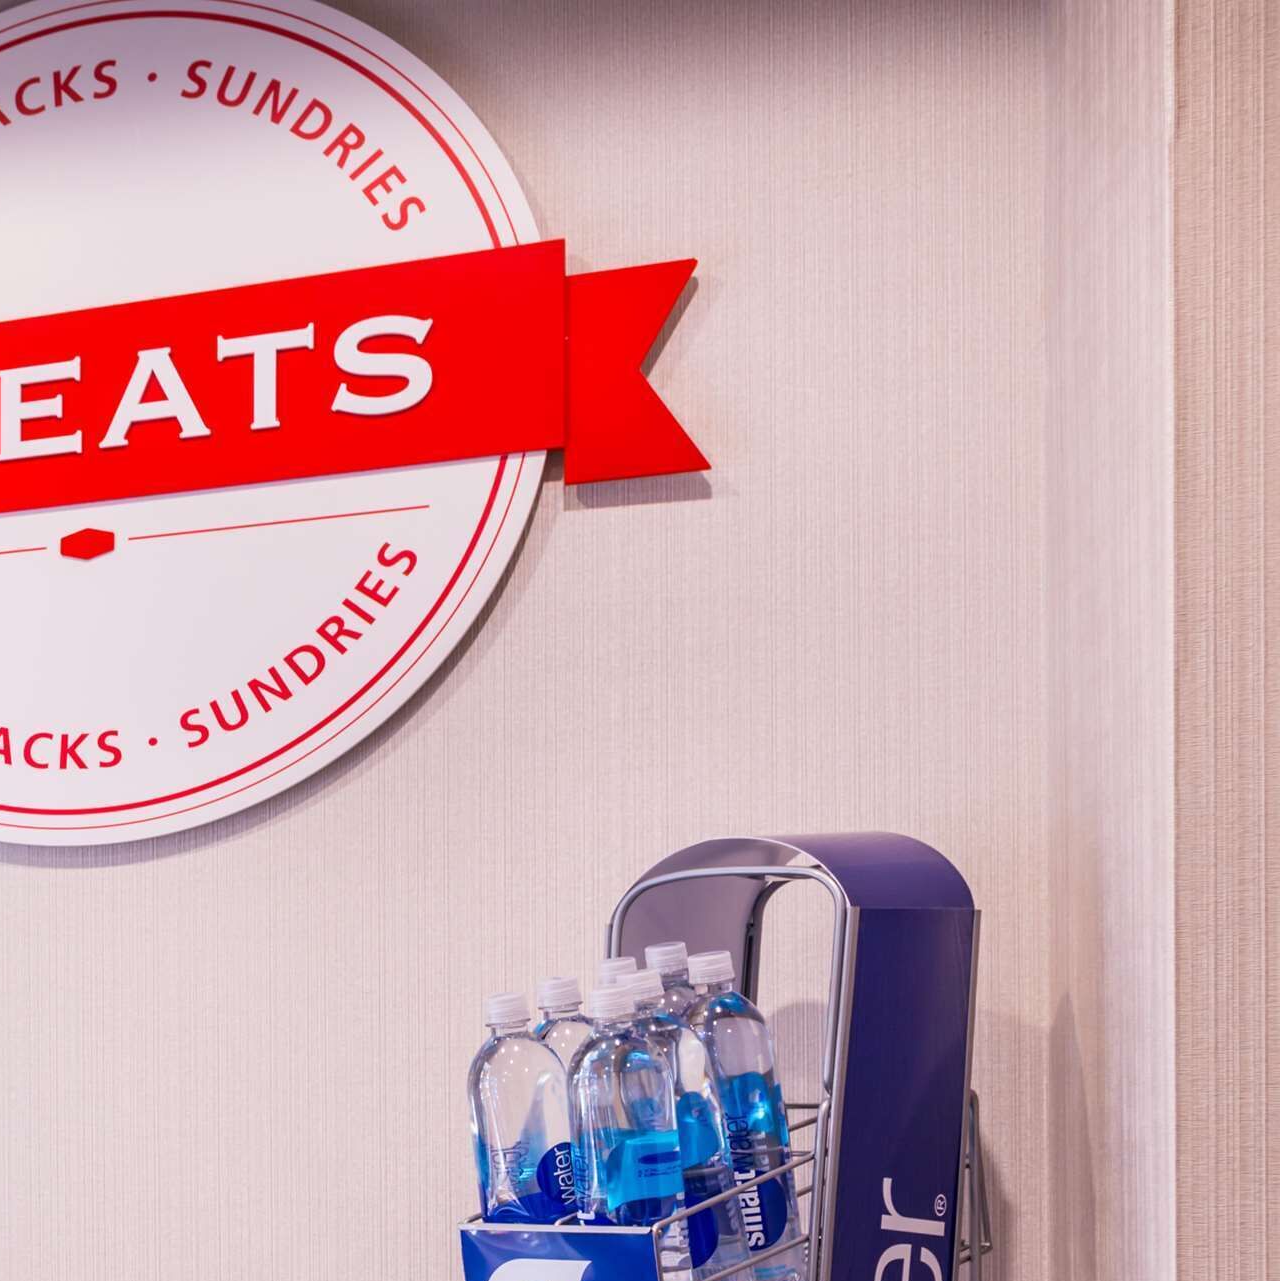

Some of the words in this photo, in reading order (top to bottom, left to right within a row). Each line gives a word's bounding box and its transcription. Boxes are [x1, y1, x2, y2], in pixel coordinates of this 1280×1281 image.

[181, 58, 426, 231] SUNDRIES
[180, 542, 419, 750] SUNDRIES
[553, 1146, 576, 1205] water
